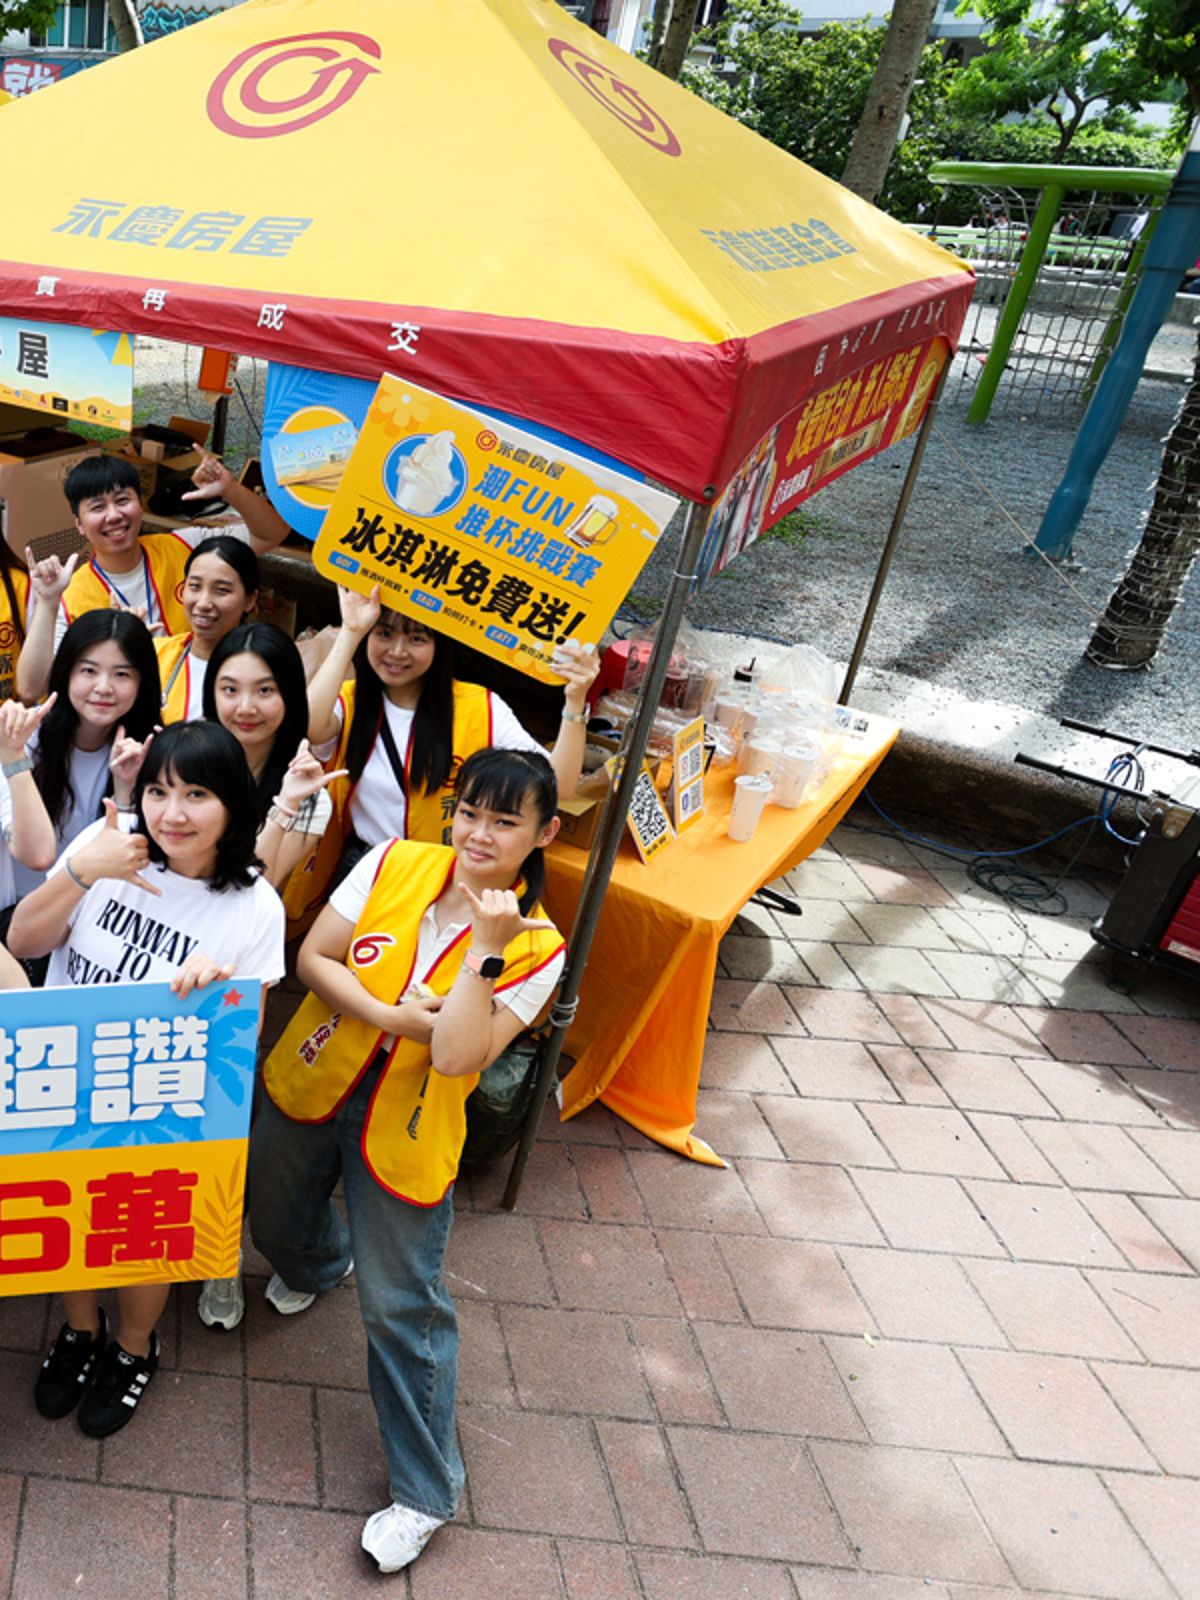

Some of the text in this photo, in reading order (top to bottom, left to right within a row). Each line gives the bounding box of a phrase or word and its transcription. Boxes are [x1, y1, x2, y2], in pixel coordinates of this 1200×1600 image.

[51, 197, 313, 257] 永慶房屋
[473, 463, 575, 527] 潮FUN
[339, 507, 586, 645] 冰淇淋免費送!
[455, 503, 603, 588] 推杯挑戰賽
[96, 898, 199, 967] RUNWAY
[115, 943, 152, 982] TO
[352, 933, 395, 967] 6
